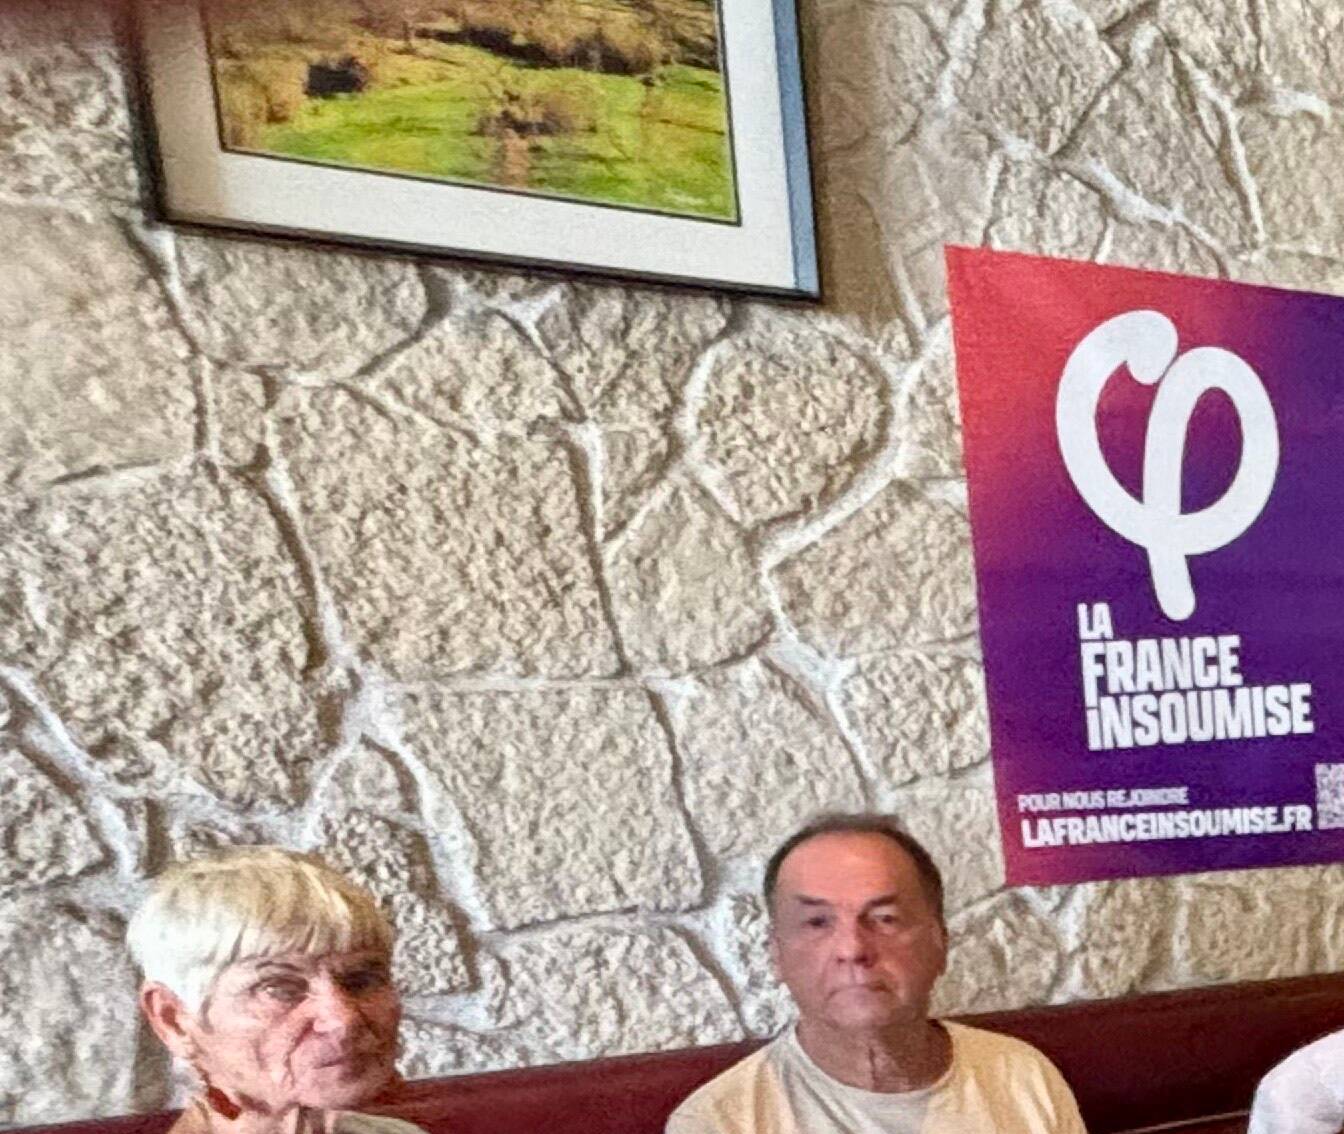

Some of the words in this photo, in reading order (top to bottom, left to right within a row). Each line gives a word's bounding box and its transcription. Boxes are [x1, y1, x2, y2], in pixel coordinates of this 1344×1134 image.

[1077, 602, 1113, 640] LA
[1081, 635, 1242, 706] FRANCE
[1017, 793, 1060, 813] POUR
[1062, 790, 1105, 811] NOUS
[1021, 804, 1313, 848] LAFRANCEINSOUMISE.FR
